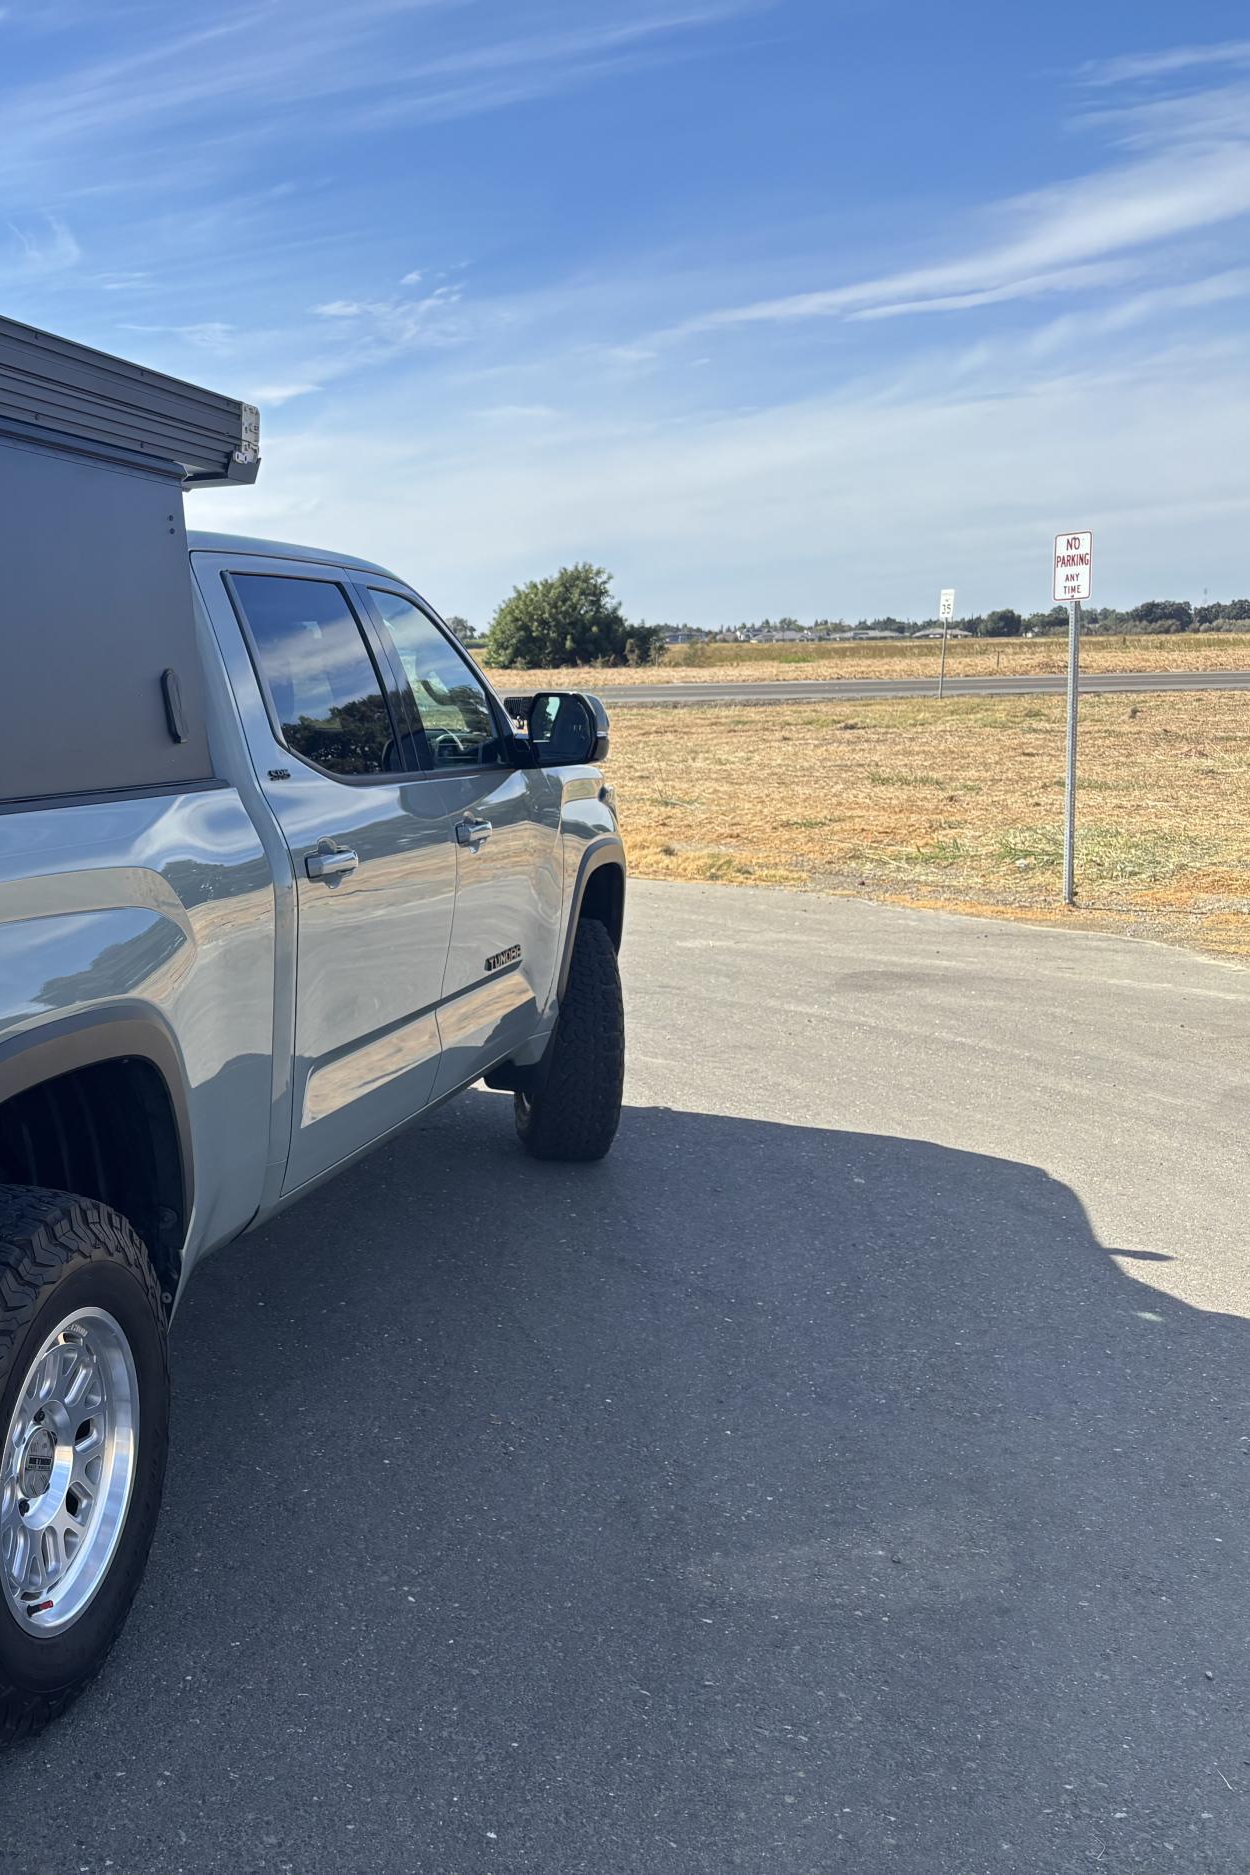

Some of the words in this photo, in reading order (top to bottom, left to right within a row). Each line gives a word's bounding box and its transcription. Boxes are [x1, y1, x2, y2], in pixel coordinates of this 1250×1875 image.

[1066, 536, 1081, 551] NO
[1056, 553, 1090, 568] PARKING
[1065, 572, 1080, 583] ANY
[1063, 584, 1082, 595] TIME
